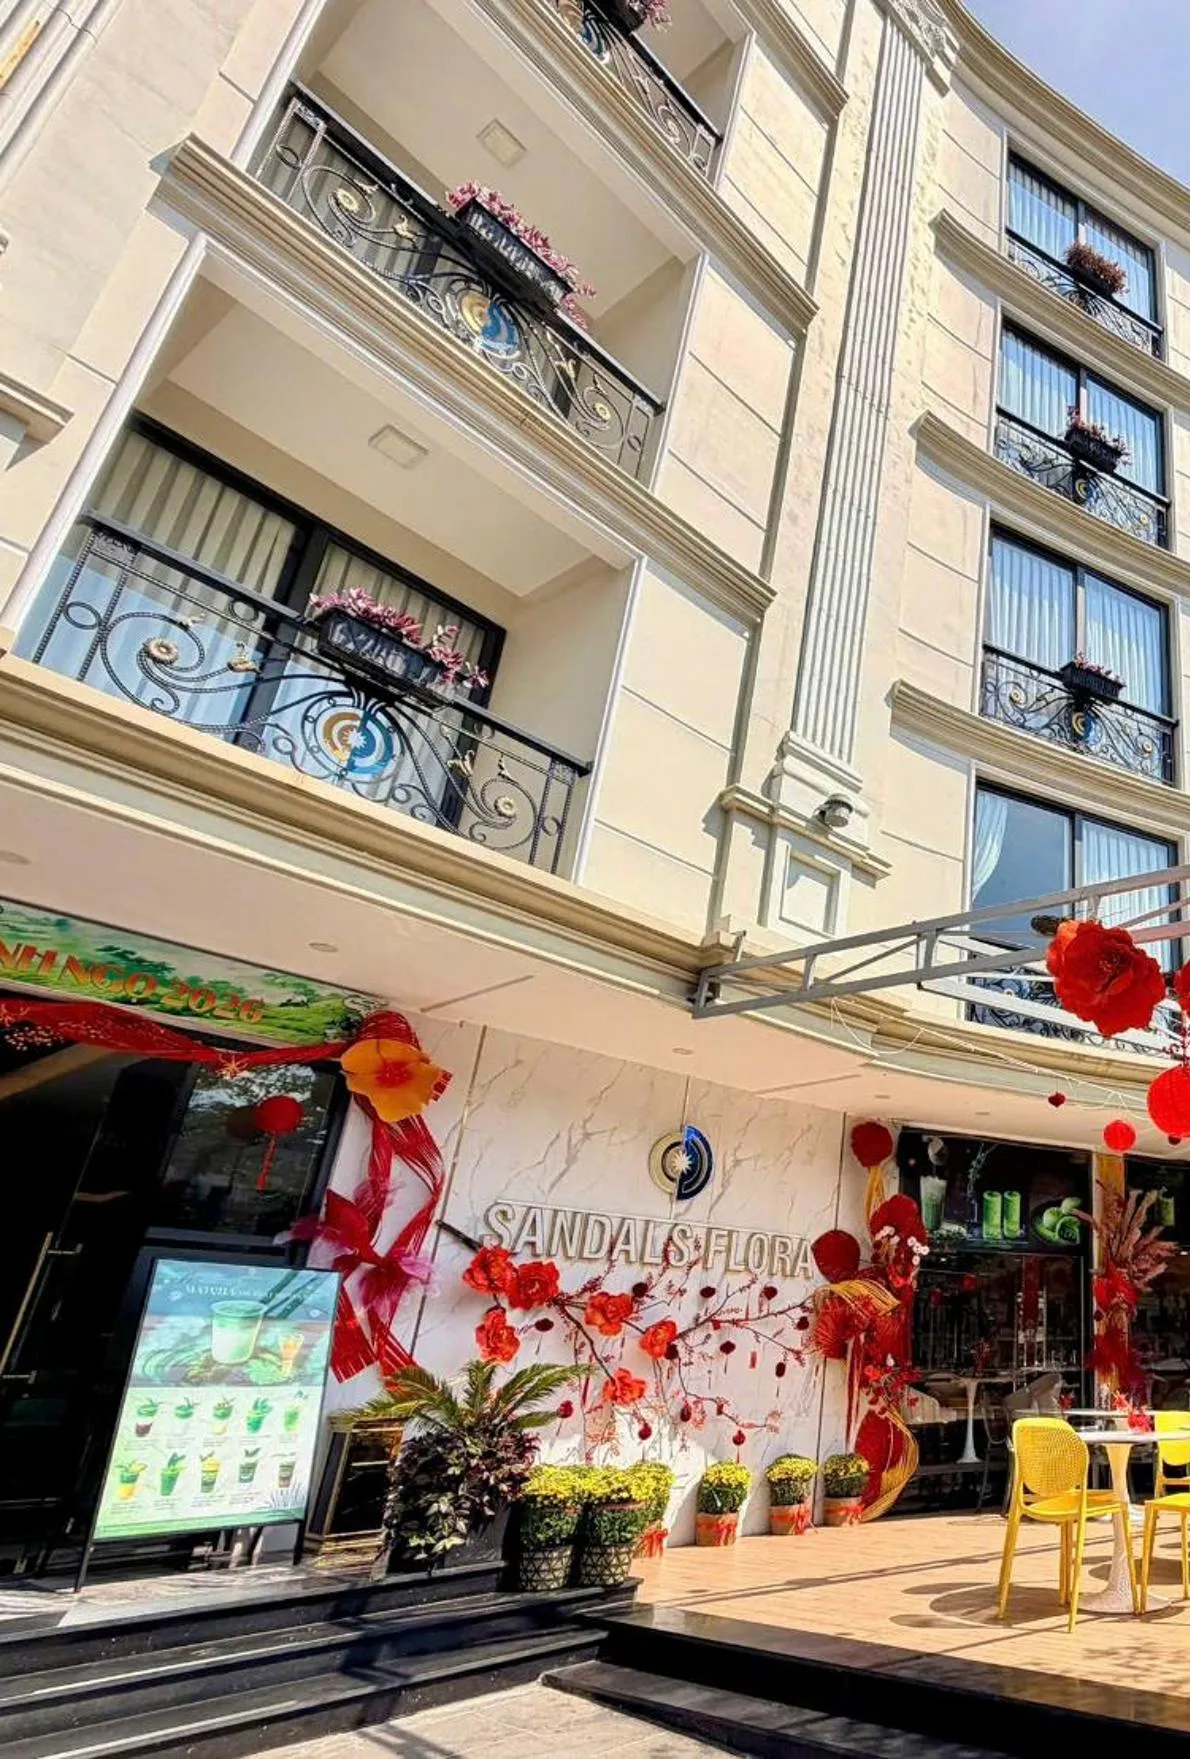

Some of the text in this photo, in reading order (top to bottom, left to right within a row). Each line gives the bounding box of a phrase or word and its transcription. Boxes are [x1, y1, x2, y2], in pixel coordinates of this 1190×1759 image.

[160, 974, 266, 1024] 2026
[482, 1201, 815, 1279] SANDALS FLORA
